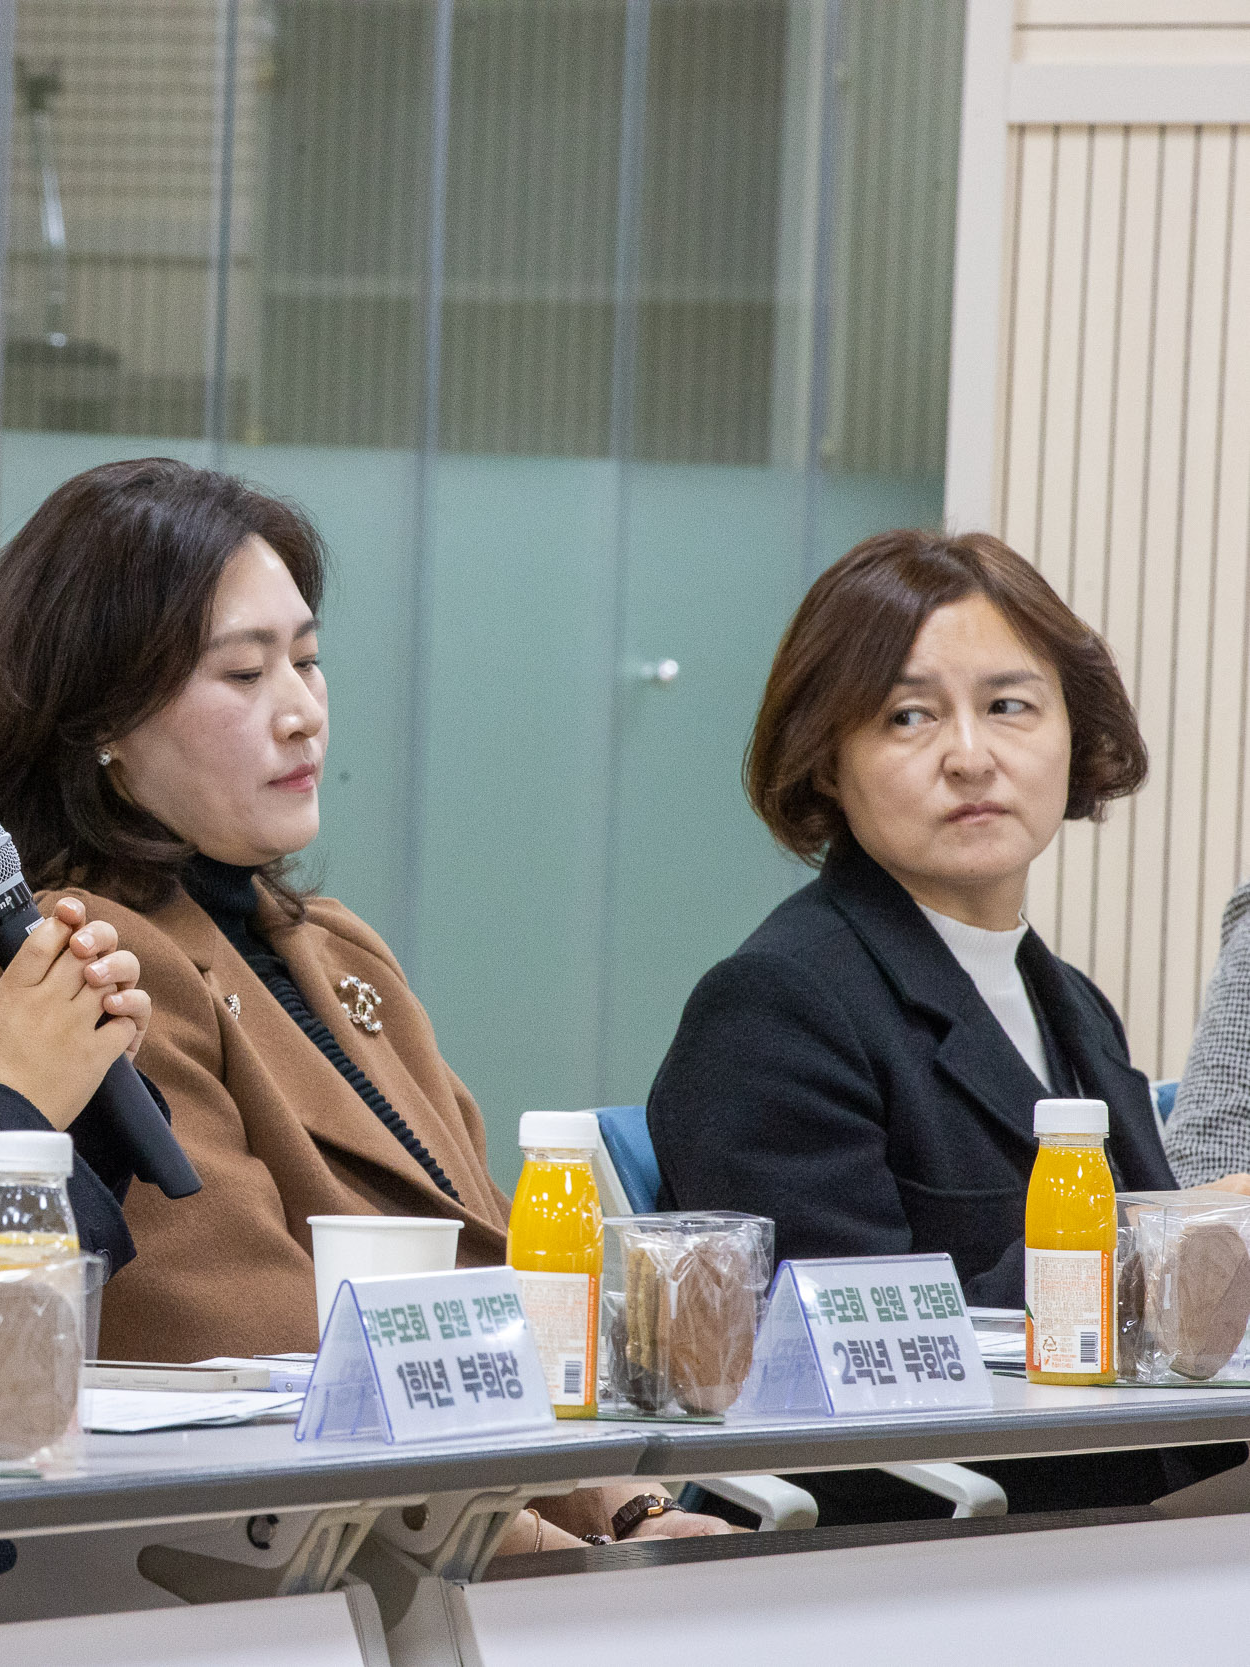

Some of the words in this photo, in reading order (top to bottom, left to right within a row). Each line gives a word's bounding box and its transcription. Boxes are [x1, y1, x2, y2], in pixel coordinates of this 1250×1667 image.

[433, 1300, 472, 1339] 임원
[472, 1293, 526, 1334] 간담회
[870, 1286, 909, 1322] 임원
[909, 1282, 965, 1320] 간담회
[397, 1358, 455, 1409] 1학년
[457, 1350, 524, 1404] 부회장
[834, 1339, 897, 1386] 2학년
[898, 1334, 966, 1383] 부회장
